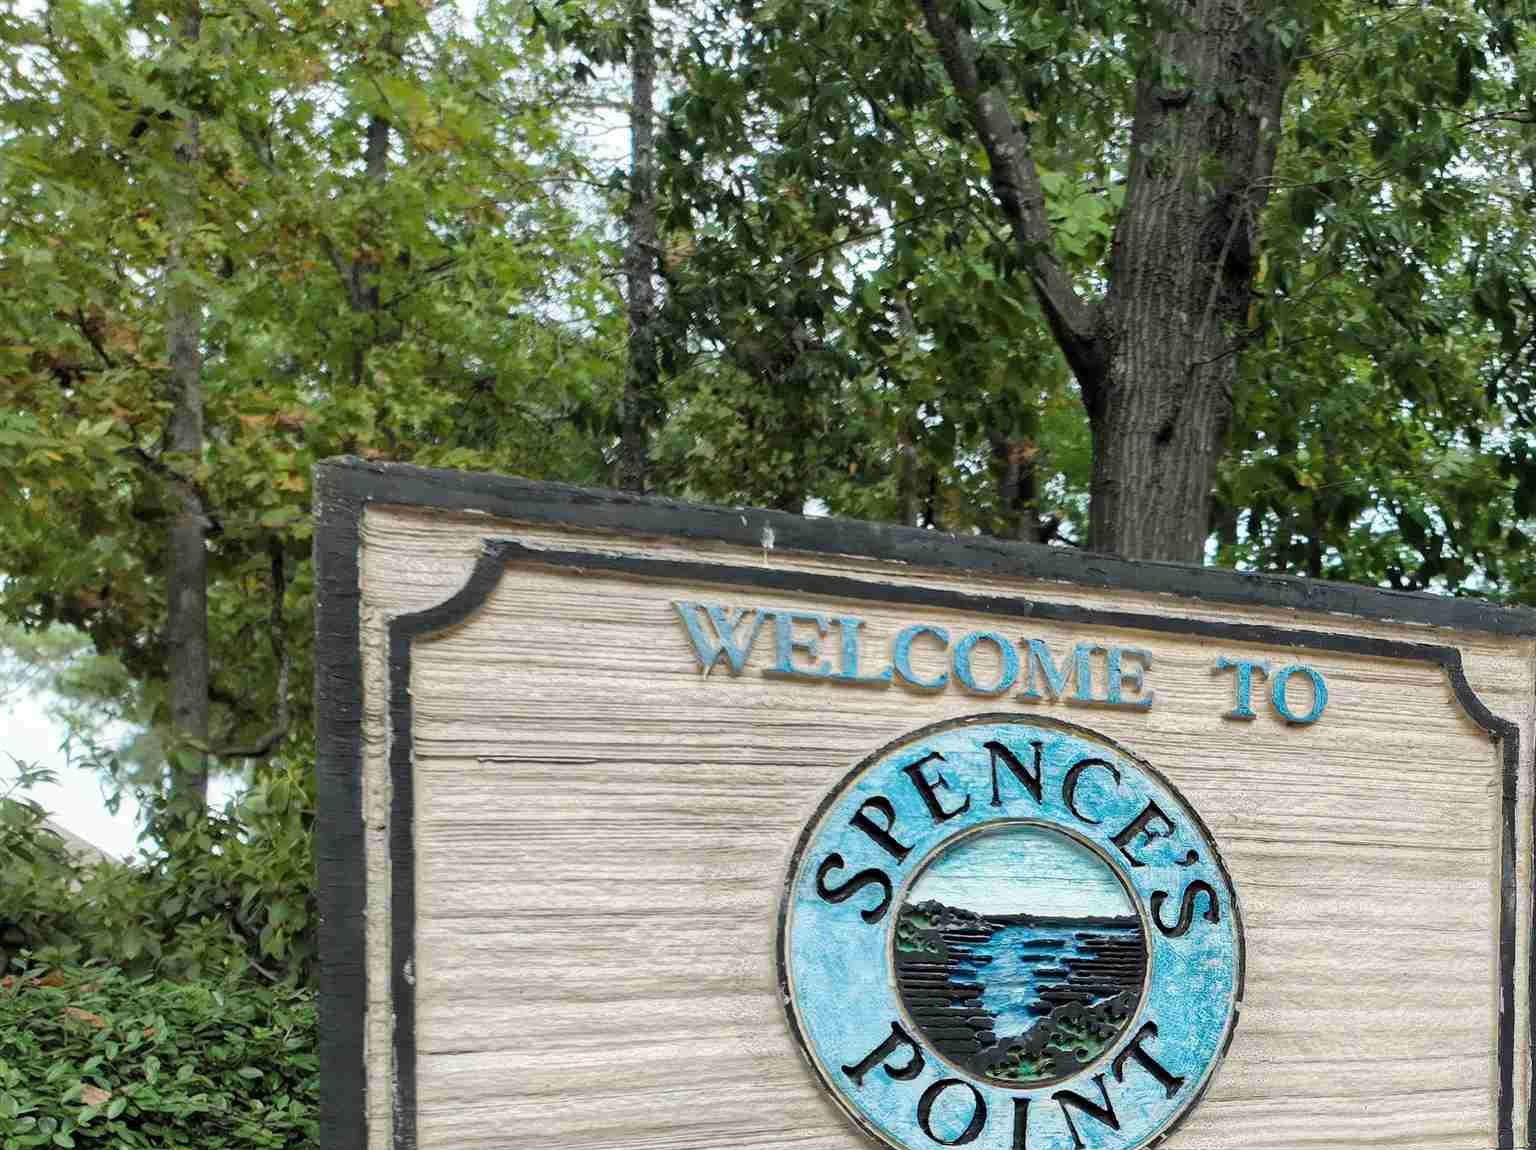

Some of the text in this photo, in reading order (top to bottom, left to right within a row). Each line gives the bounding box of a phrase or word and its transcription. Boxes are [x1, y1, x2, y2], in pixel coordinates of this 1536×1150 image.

[673, 600, 1328, 724] WELCOME TO
[816, 741, 1219, 938] SPENCE'S
